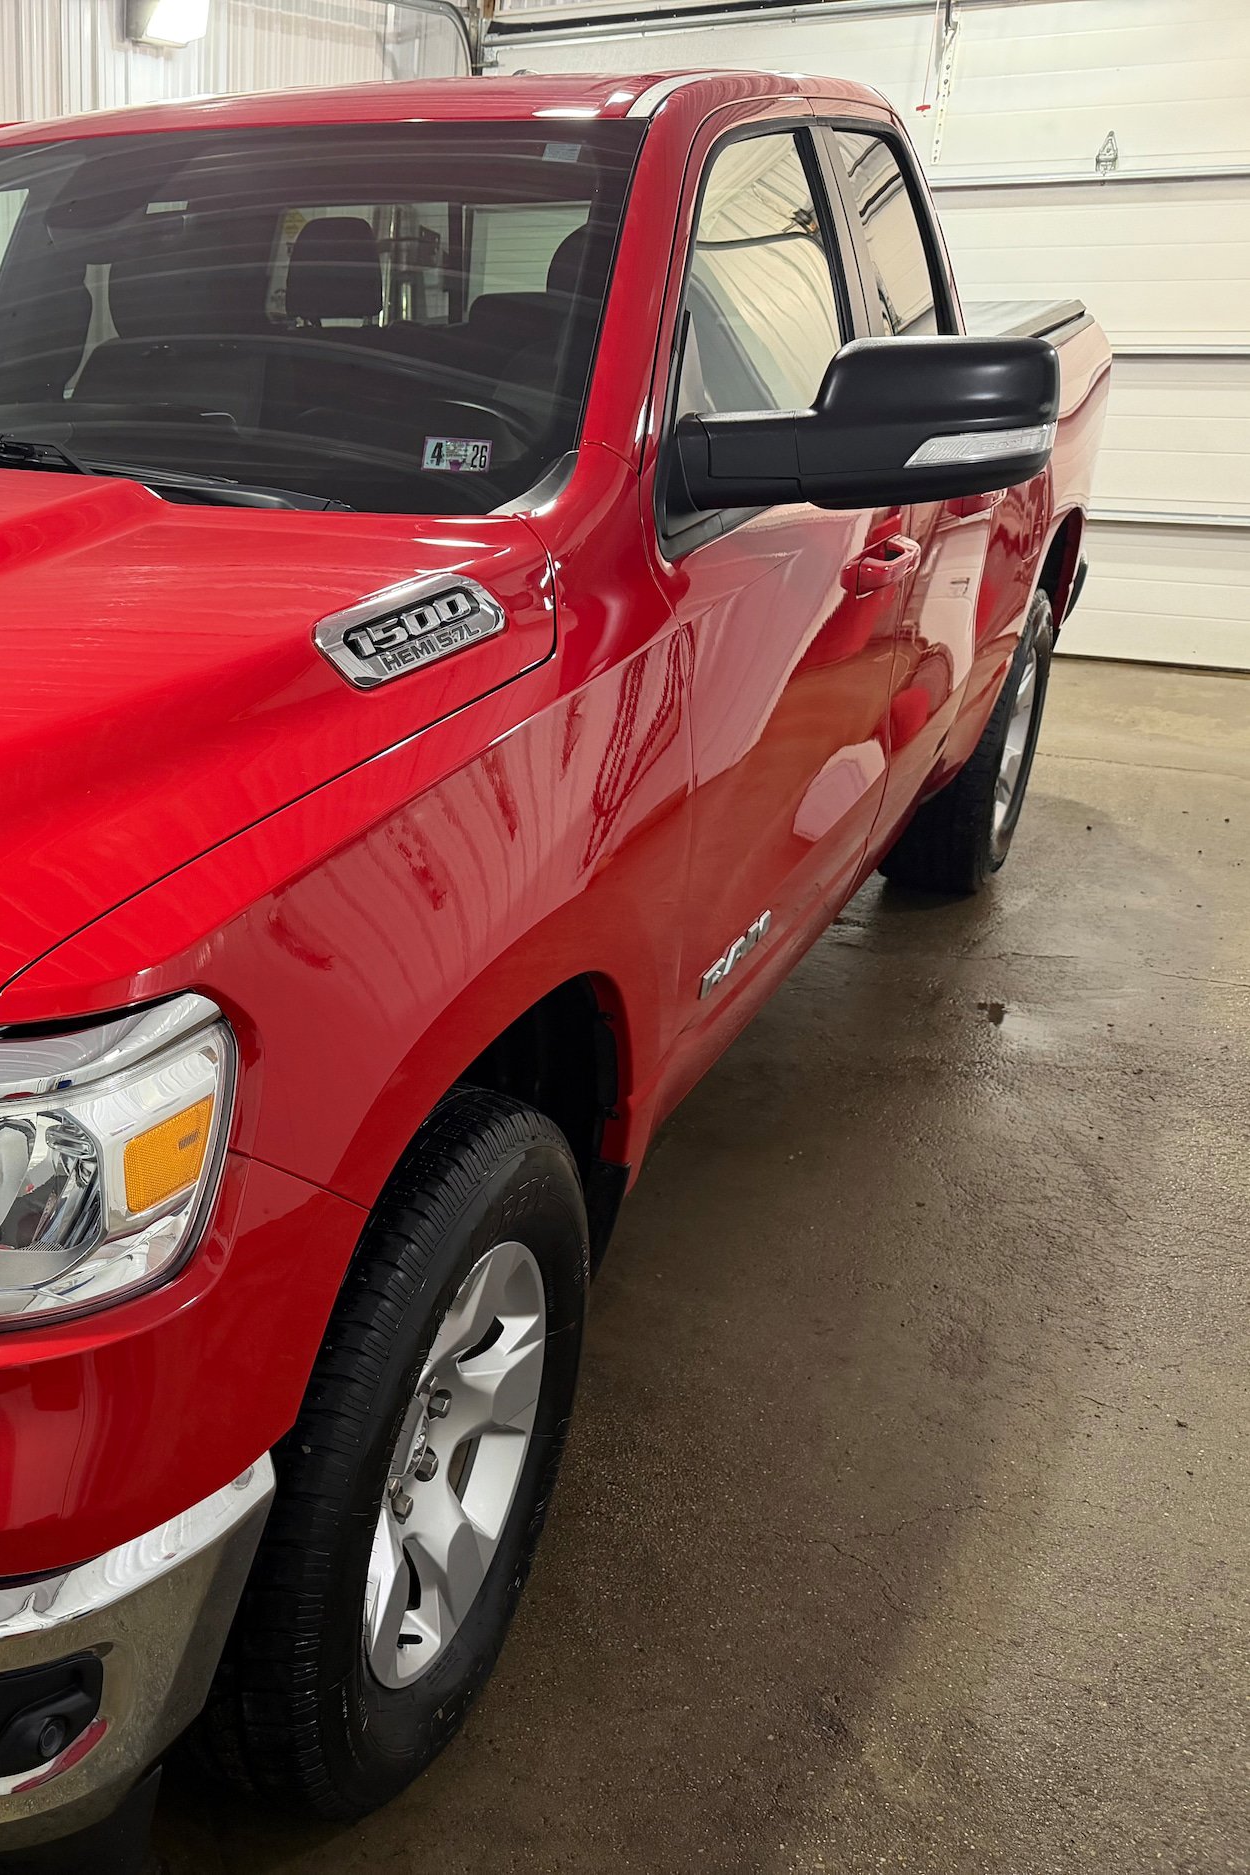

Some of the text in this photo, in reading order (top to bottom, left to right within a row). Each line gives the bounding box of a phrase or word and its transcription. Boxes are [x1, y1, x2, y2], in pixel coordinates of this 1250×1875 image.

[430, 442, 444, 466] 4
[470, 444, 488, 469] 26
[347, 592, 472, 657] 1500
[379, 620, 482, 673] HEMI 5.7L
